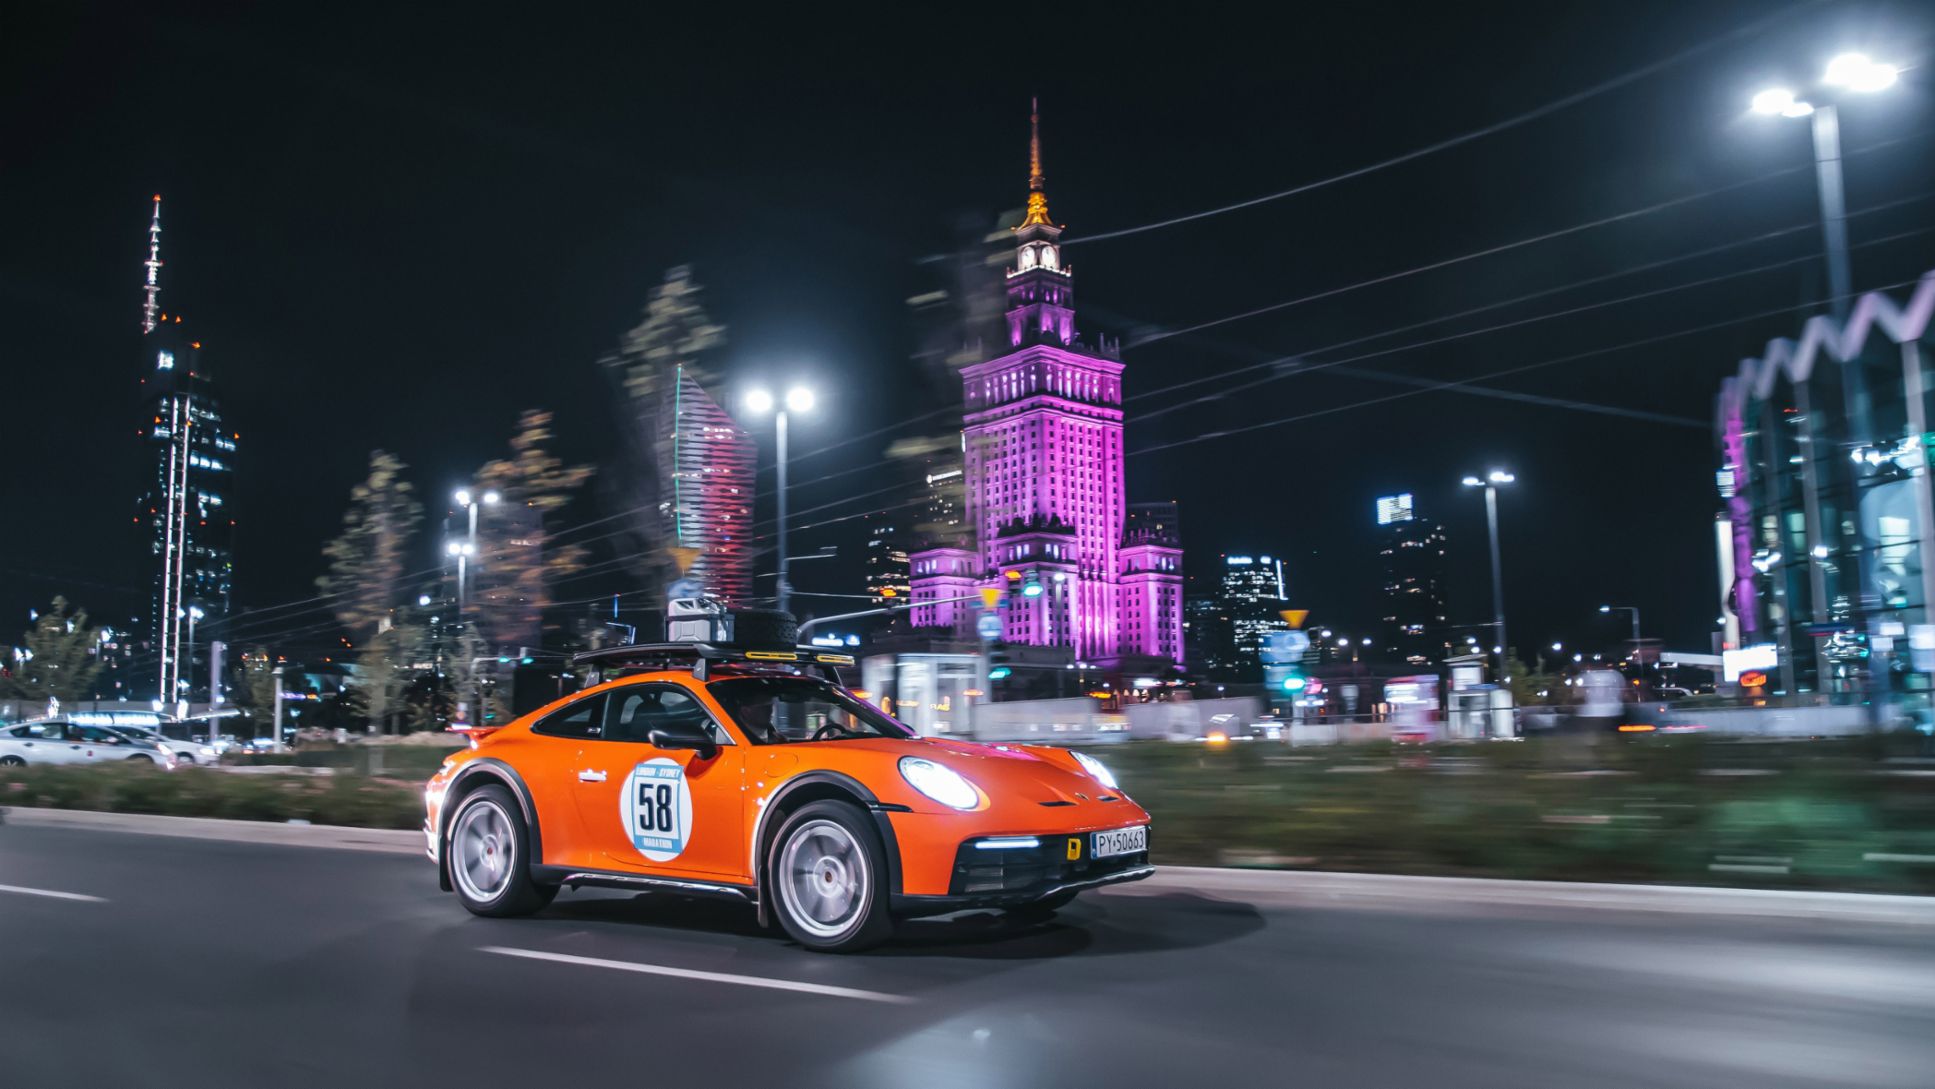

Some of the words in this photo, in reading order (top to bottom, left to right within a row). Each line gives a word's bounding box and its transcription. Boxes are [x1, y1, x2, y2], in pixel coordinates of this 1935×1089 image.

[639, 783, 673, 832] 58
[1099, 834, 1113, 855] PY
[1116, 831, 1144, 851] 50663
